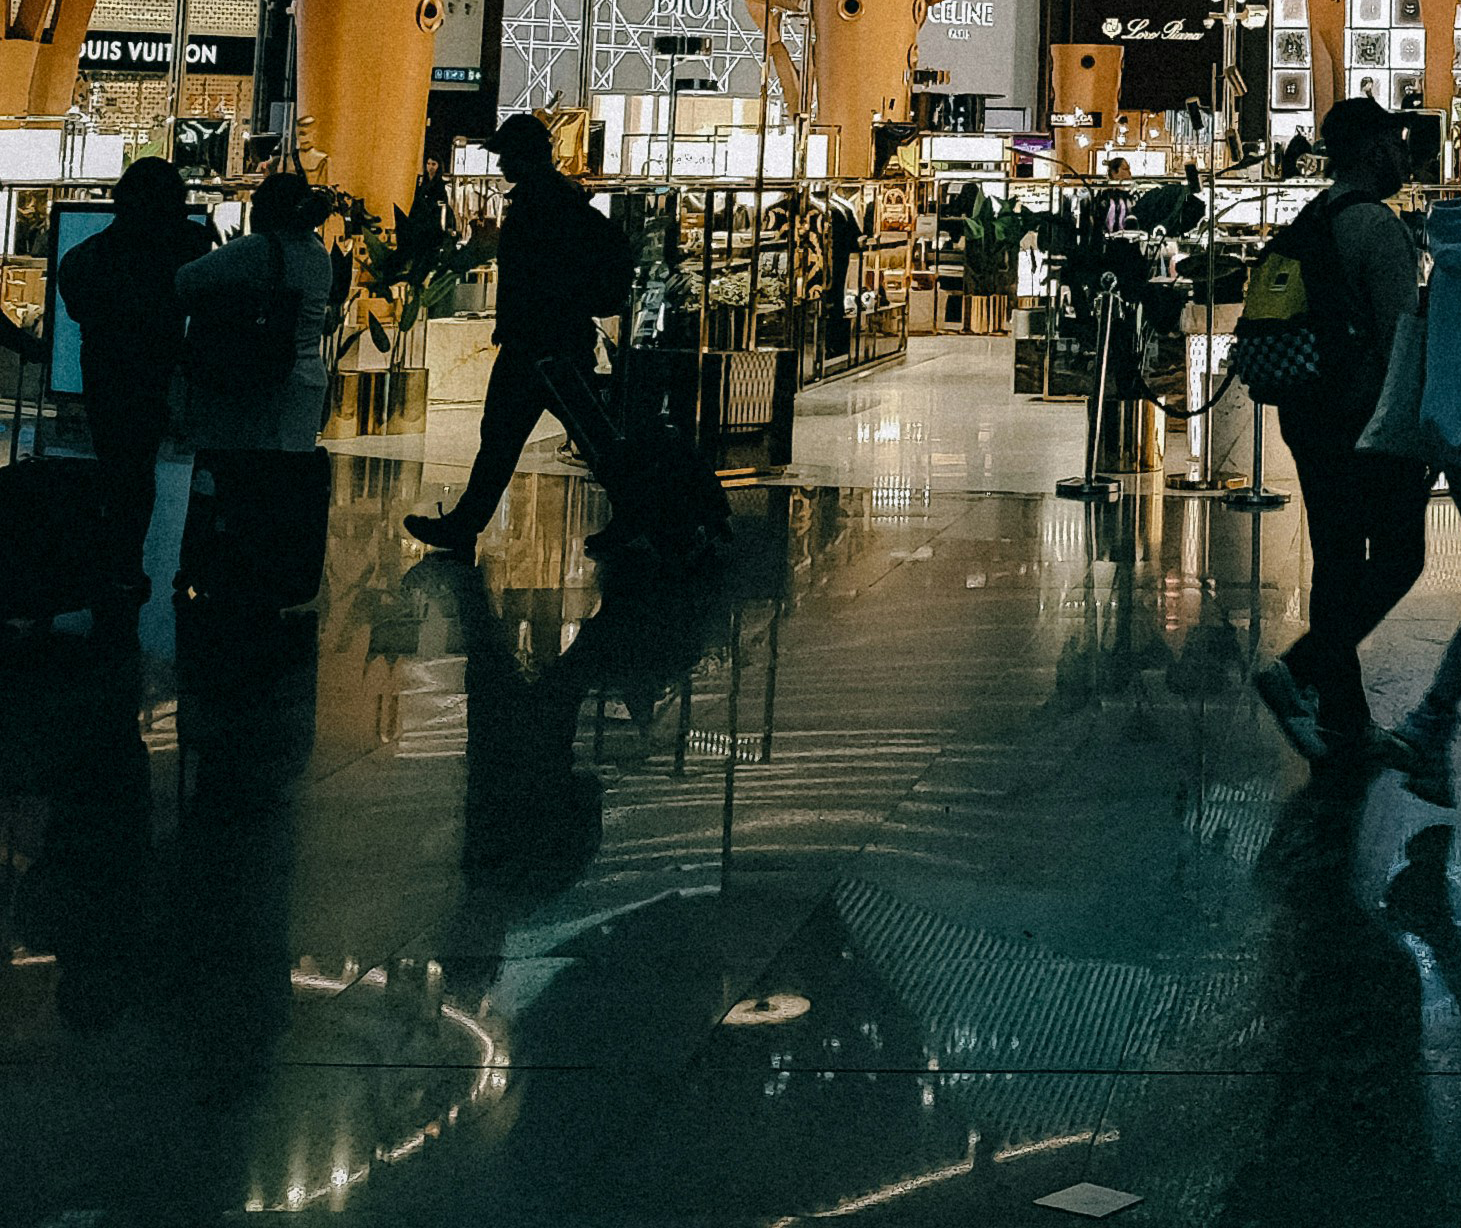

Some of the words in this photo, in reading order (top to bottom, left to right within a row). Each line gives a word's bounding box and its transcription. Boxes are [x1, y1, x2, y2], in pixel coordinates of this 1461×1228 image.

[927, 0, 994, 27] CELINE
[1120, 18, 1161, 40] Loro
[127, 41, 217, 65] VUITON
